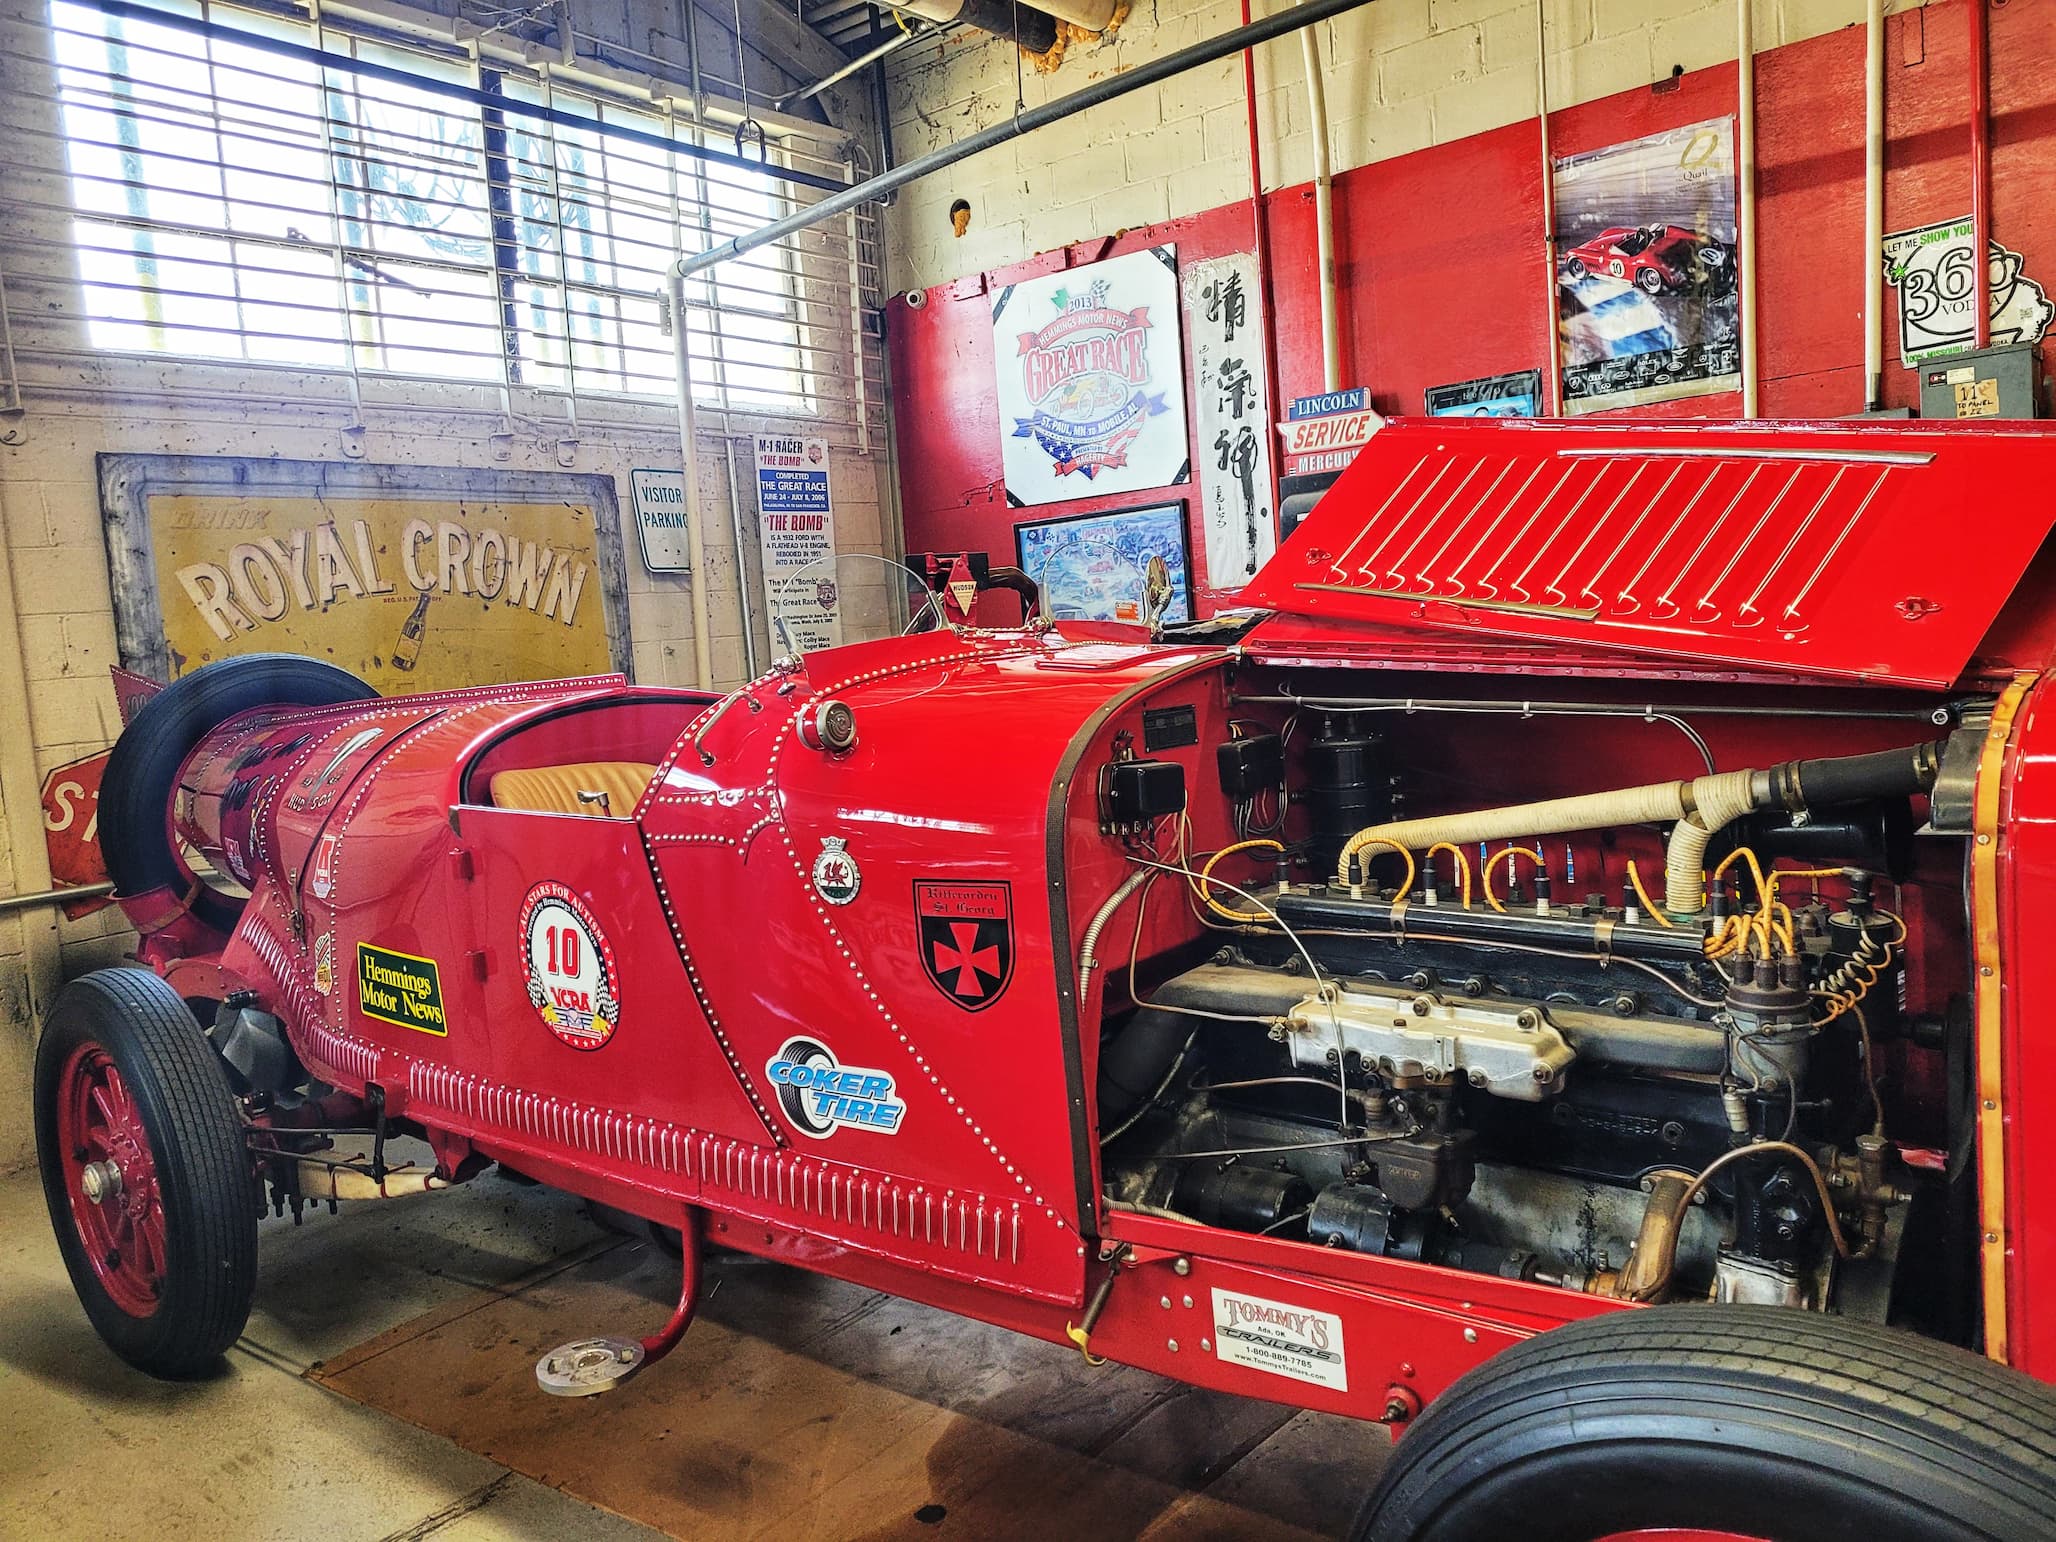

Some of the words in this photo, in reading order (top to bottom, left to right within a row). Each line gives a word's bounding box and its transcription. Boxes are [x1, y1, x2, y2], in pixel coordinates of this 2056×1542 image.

[1888, 241, 1902, 253] LET
[1905, 237, 1918, 249] ME
[1919, 229, 1950, 245] SHOW
[1611, 260, 1622, 274] 10
[1903, 247, 2016, 321] 360
[1069, 296, 1092, 312] 2013
[1943, 293, 2001, 315] VODA
[1039, 316, 1077, 346] HEMMINGS
[1078, 313, 1105, 326] MOTOR
[1106, 313, 1128, 329] NEWS
[1026, 342, 1088, 400] GREAT
[1090, 329, 1146, 383] RACE
[1298, 391, 1361, 416] LINCOLN
[1968, 399, 1993, 408] PANEL
[1052, 420, 1072, 435] PAUL,
[1074, 424, 1087, 436] MN
[1098, 411, 1129, 434] MOBILE,
[1294, 415, 1370, 449] SERVICE
[759, 439, 773, 452] M-1
[776, 440, 803, 454] RACER
[761, 481, 776, 490] THE
[778, 481, 803, 491] GREAT
[805, 482, 827, 491] RACE
[775, 472, 810, 480] COMPLETED
[641, 486, 682, 504] VISITOR
[170, 508, 271, 529] DRINK
[175, 519, 398, 642] ROYAL
[401, 518, 588, 629] CROWN
[953, 583, 974, 591] HUDSON
[520, 905, 531, 928] ALL
[527, 885, 550, 906] STARS
[552, 884, 570, 900] FOR
[571, 897, 604, 942] AUTISM
[543, 898, 571, 912] Hemmings
[934, 901, 953, 913] St.
[545, 926, 580, 977] 10
[363, 954, 432, 1000] Hemmings
[362, 979, 398, 1013] Motor
[401, 990, 443, 1024] News
[769, 1061, 892, 1101] COKER
[813, 1092, 903, 1128] TIRE
[1224, 1298, 1330, 1350] TOMMY'S
[1223, 1328, 1332, 1361] TRAILERS
